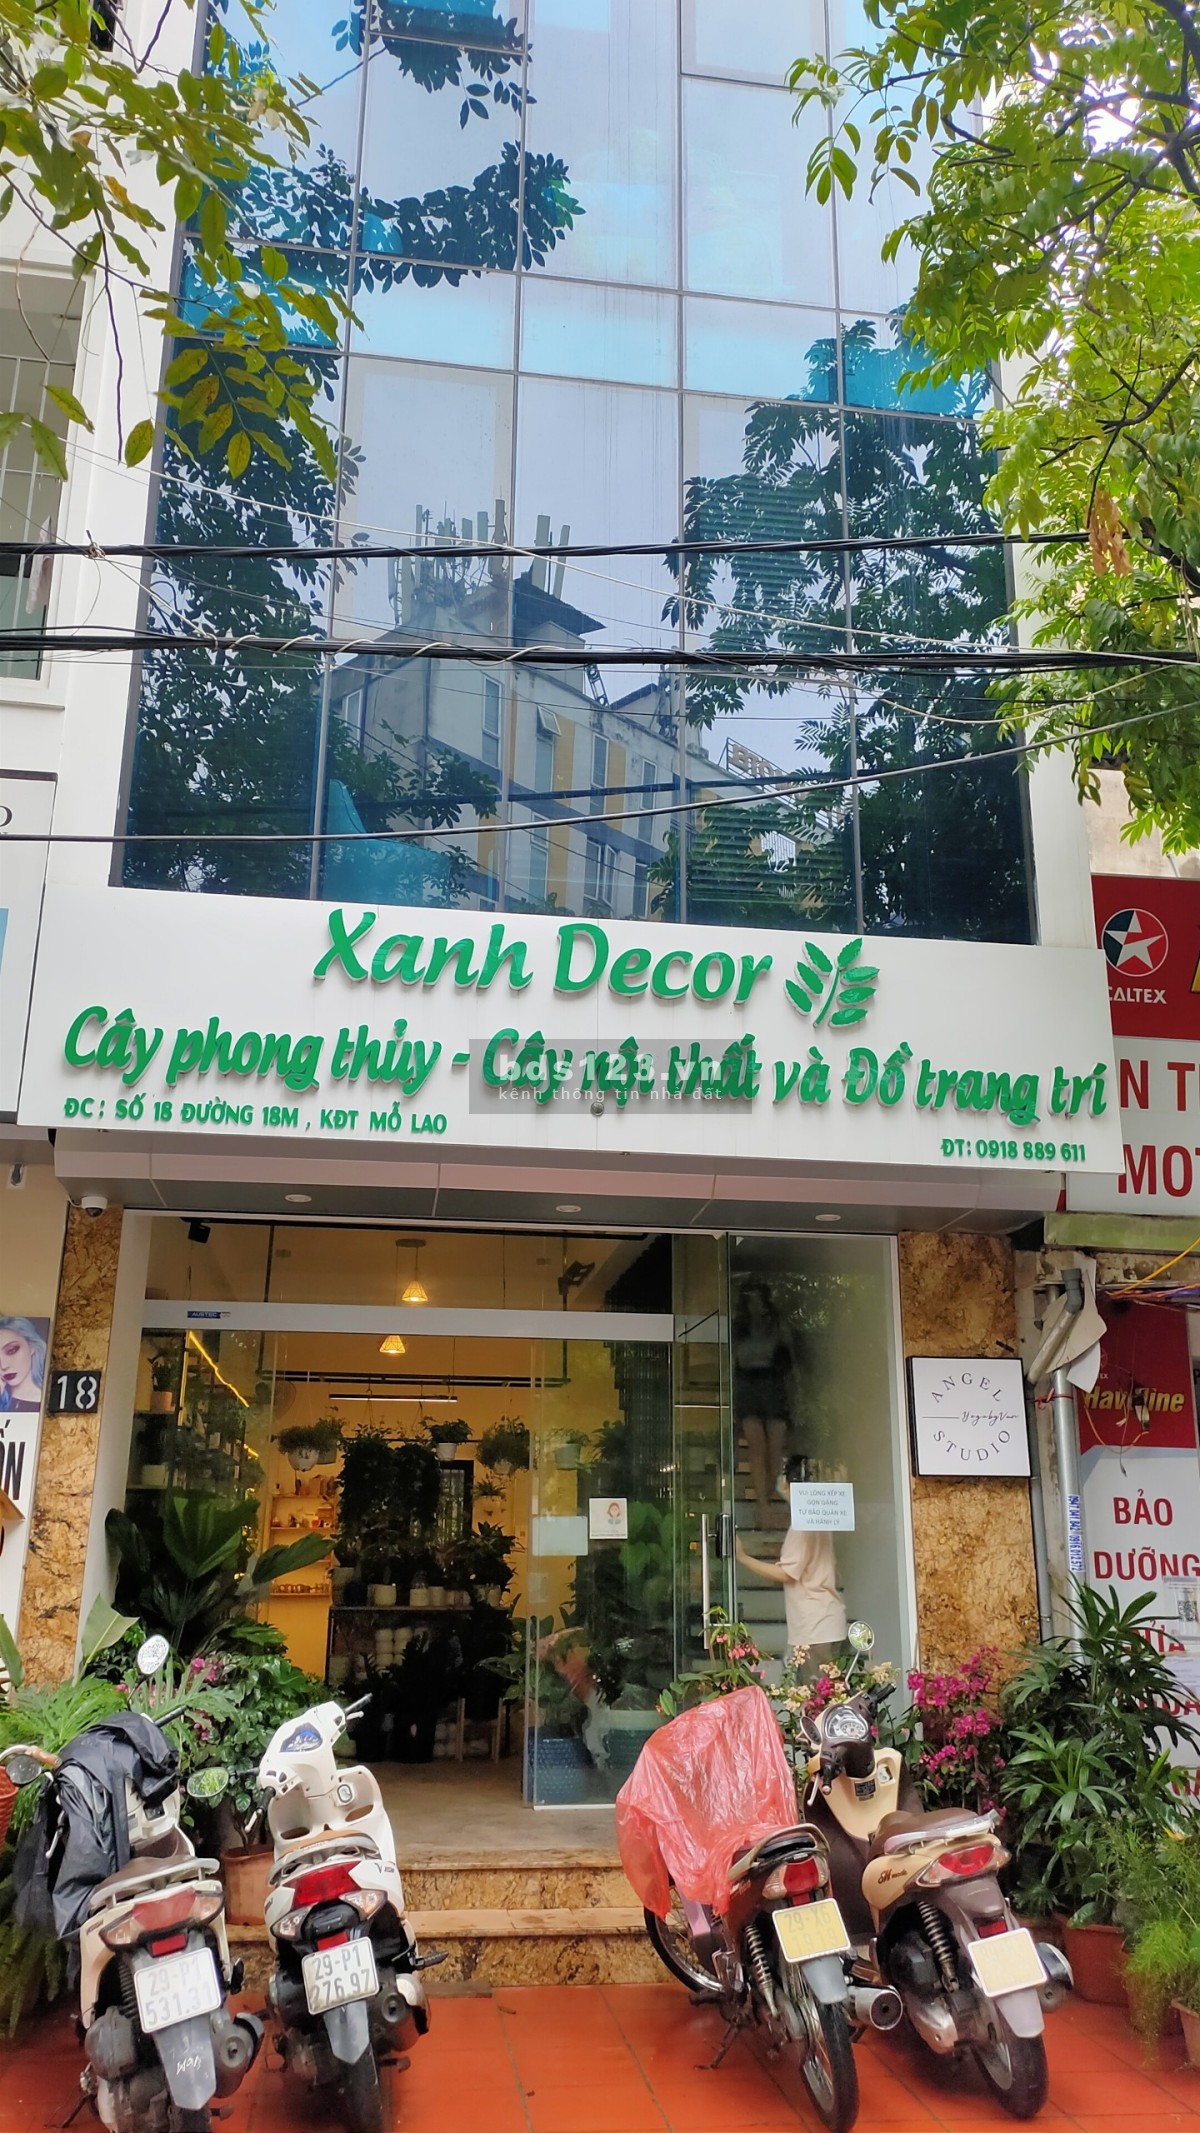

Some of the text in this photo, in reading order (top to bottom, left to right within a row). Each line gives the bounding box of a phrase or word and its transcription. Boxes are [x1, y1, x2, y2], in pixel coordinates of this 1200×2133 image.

[314, 909, 773, 1005] Xanh Decor
[64, 1006, 163, 1085] Cây
[165, 1017, 324, 1092] phong
[330, 1019, 442, 1096] thủy
[483, 1028, 573, 1104] Cây
[667, 1033, 763, 1100] thất
[772, 1046, 831, 1104] và
[844, 1041, 913, 1106] Đồ
[915, 1058, 1040, 1127] trang
[1049, 1062, 1107, 1116] trí
[1167, 1062, 1200, 1112] T
[116, 1093, 145, 1121] SỐ
[154, 1102, 173, 1122] 18
[181, 1098, 253, 1126] ĐƯỜNG
[320, 1110, 359, 1131] KĐT
[370, 1102, 402, 1132] MỖ
[411, 1114, 448, 1134] LAO
[976, 1139, 1018, 1159] 0918
[1023, 1141, 1056, 1161] 889
[1061, 1143, 1086, 1162] 611
[1118, 1144, 1200, 1197] MO
[57, 1375, 98, 1409] 18
[931, 1372, 1003, 1404] ANGEL
[933, 1430, 1011, 1461] STUDIO
[1113, 1488, 1173, 1526] BẢO
[147, 1956, 202, 1997] 29-P1
[312, 1944, 363, 1981] 29-P1
[145, 1980, 214, 2026] 531.31
